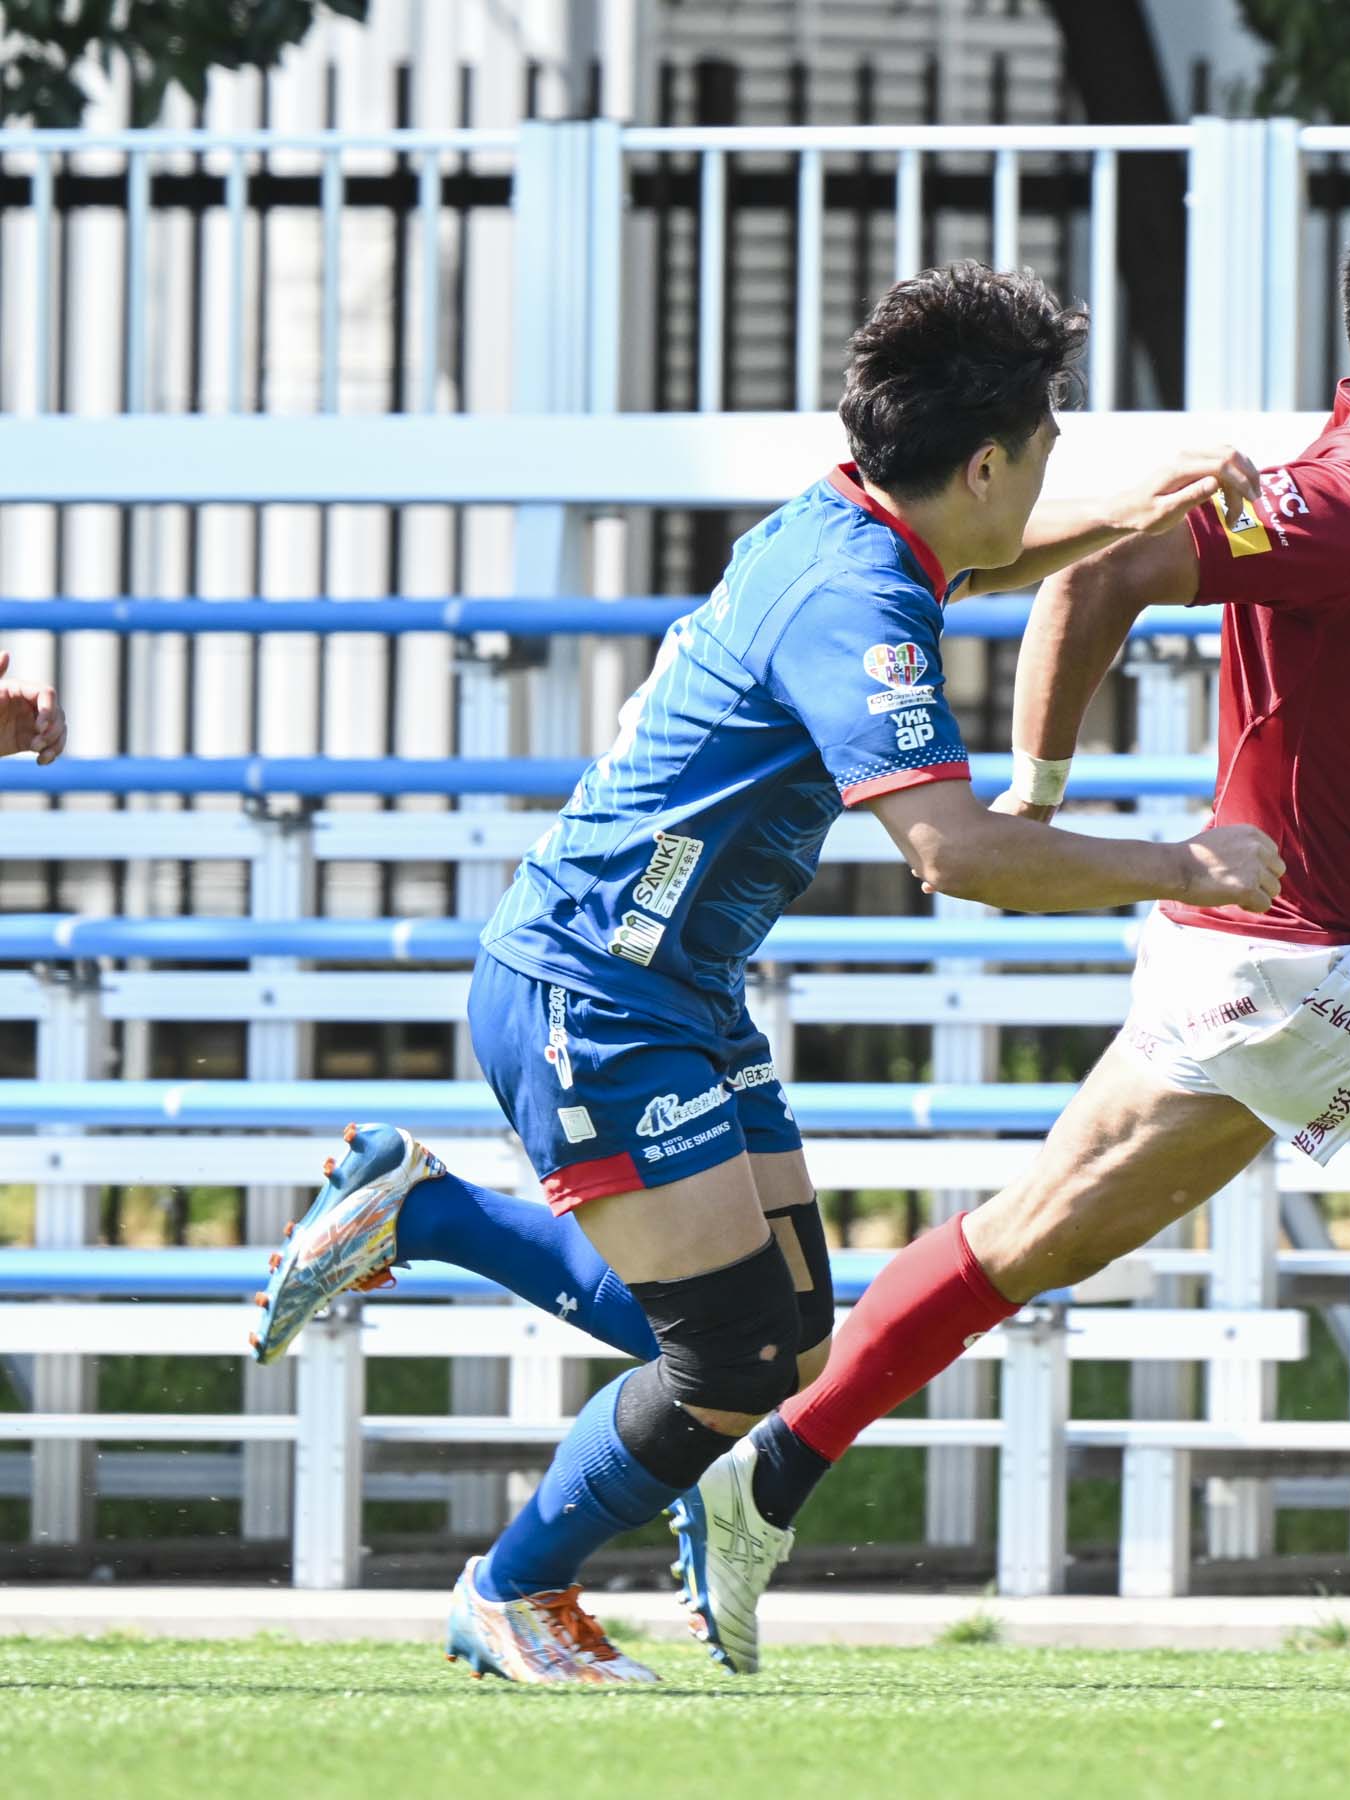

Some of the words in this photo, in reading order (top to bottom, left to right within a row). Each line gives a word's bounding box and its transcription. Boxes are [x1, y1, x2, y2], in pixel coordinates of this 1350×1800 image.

[889, 708, 931, 728] YKK
[896, 723, 935, 751] ap
[662, 1135, 684, 1146] KOTO
[664, 1138, 694, 1157] BLUE
[694, 1121, 731, 1146] SHARKS
